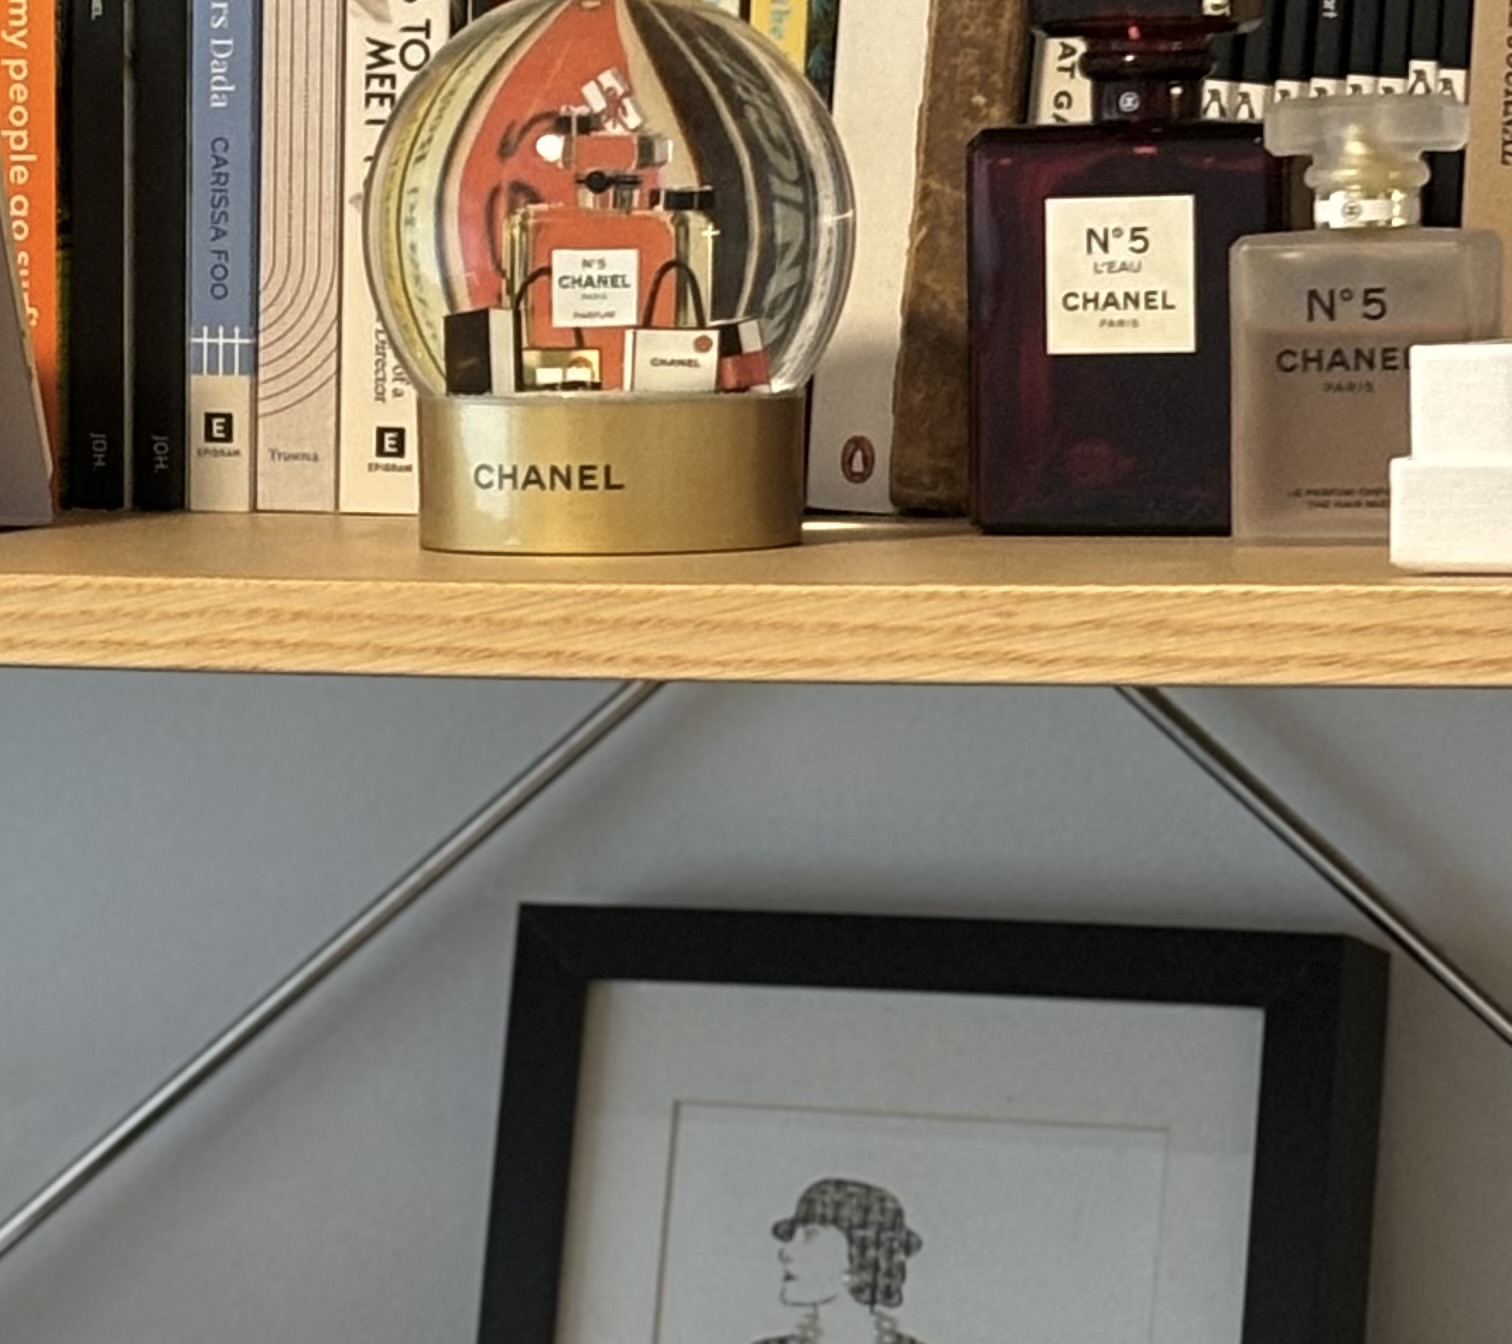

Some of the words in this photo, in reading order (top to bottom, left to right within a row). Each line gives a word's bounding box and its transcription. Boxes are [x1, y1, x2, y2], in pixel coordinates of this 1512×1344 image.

[399, 18, 432, 73] TO
[209, 39, 236, 108] Dada
[1, 58, 38, 186] people
[208, 137, 230, 242] CARISSA
[209, 249, 229, 301] FOO
[557, 274, 632, 290] CHANEL
[1060, 289, 1178, 313] CHANEL
[1097, 317, 1141, 330] PARIS
[649, 357, 702, 369] CHANEL
[1322, 379, 1375, 394] PARIS
[211, 417, 227, 439] E
[383, 431, 399, 454] E
[472, 462, 626, 492] CHANEL
